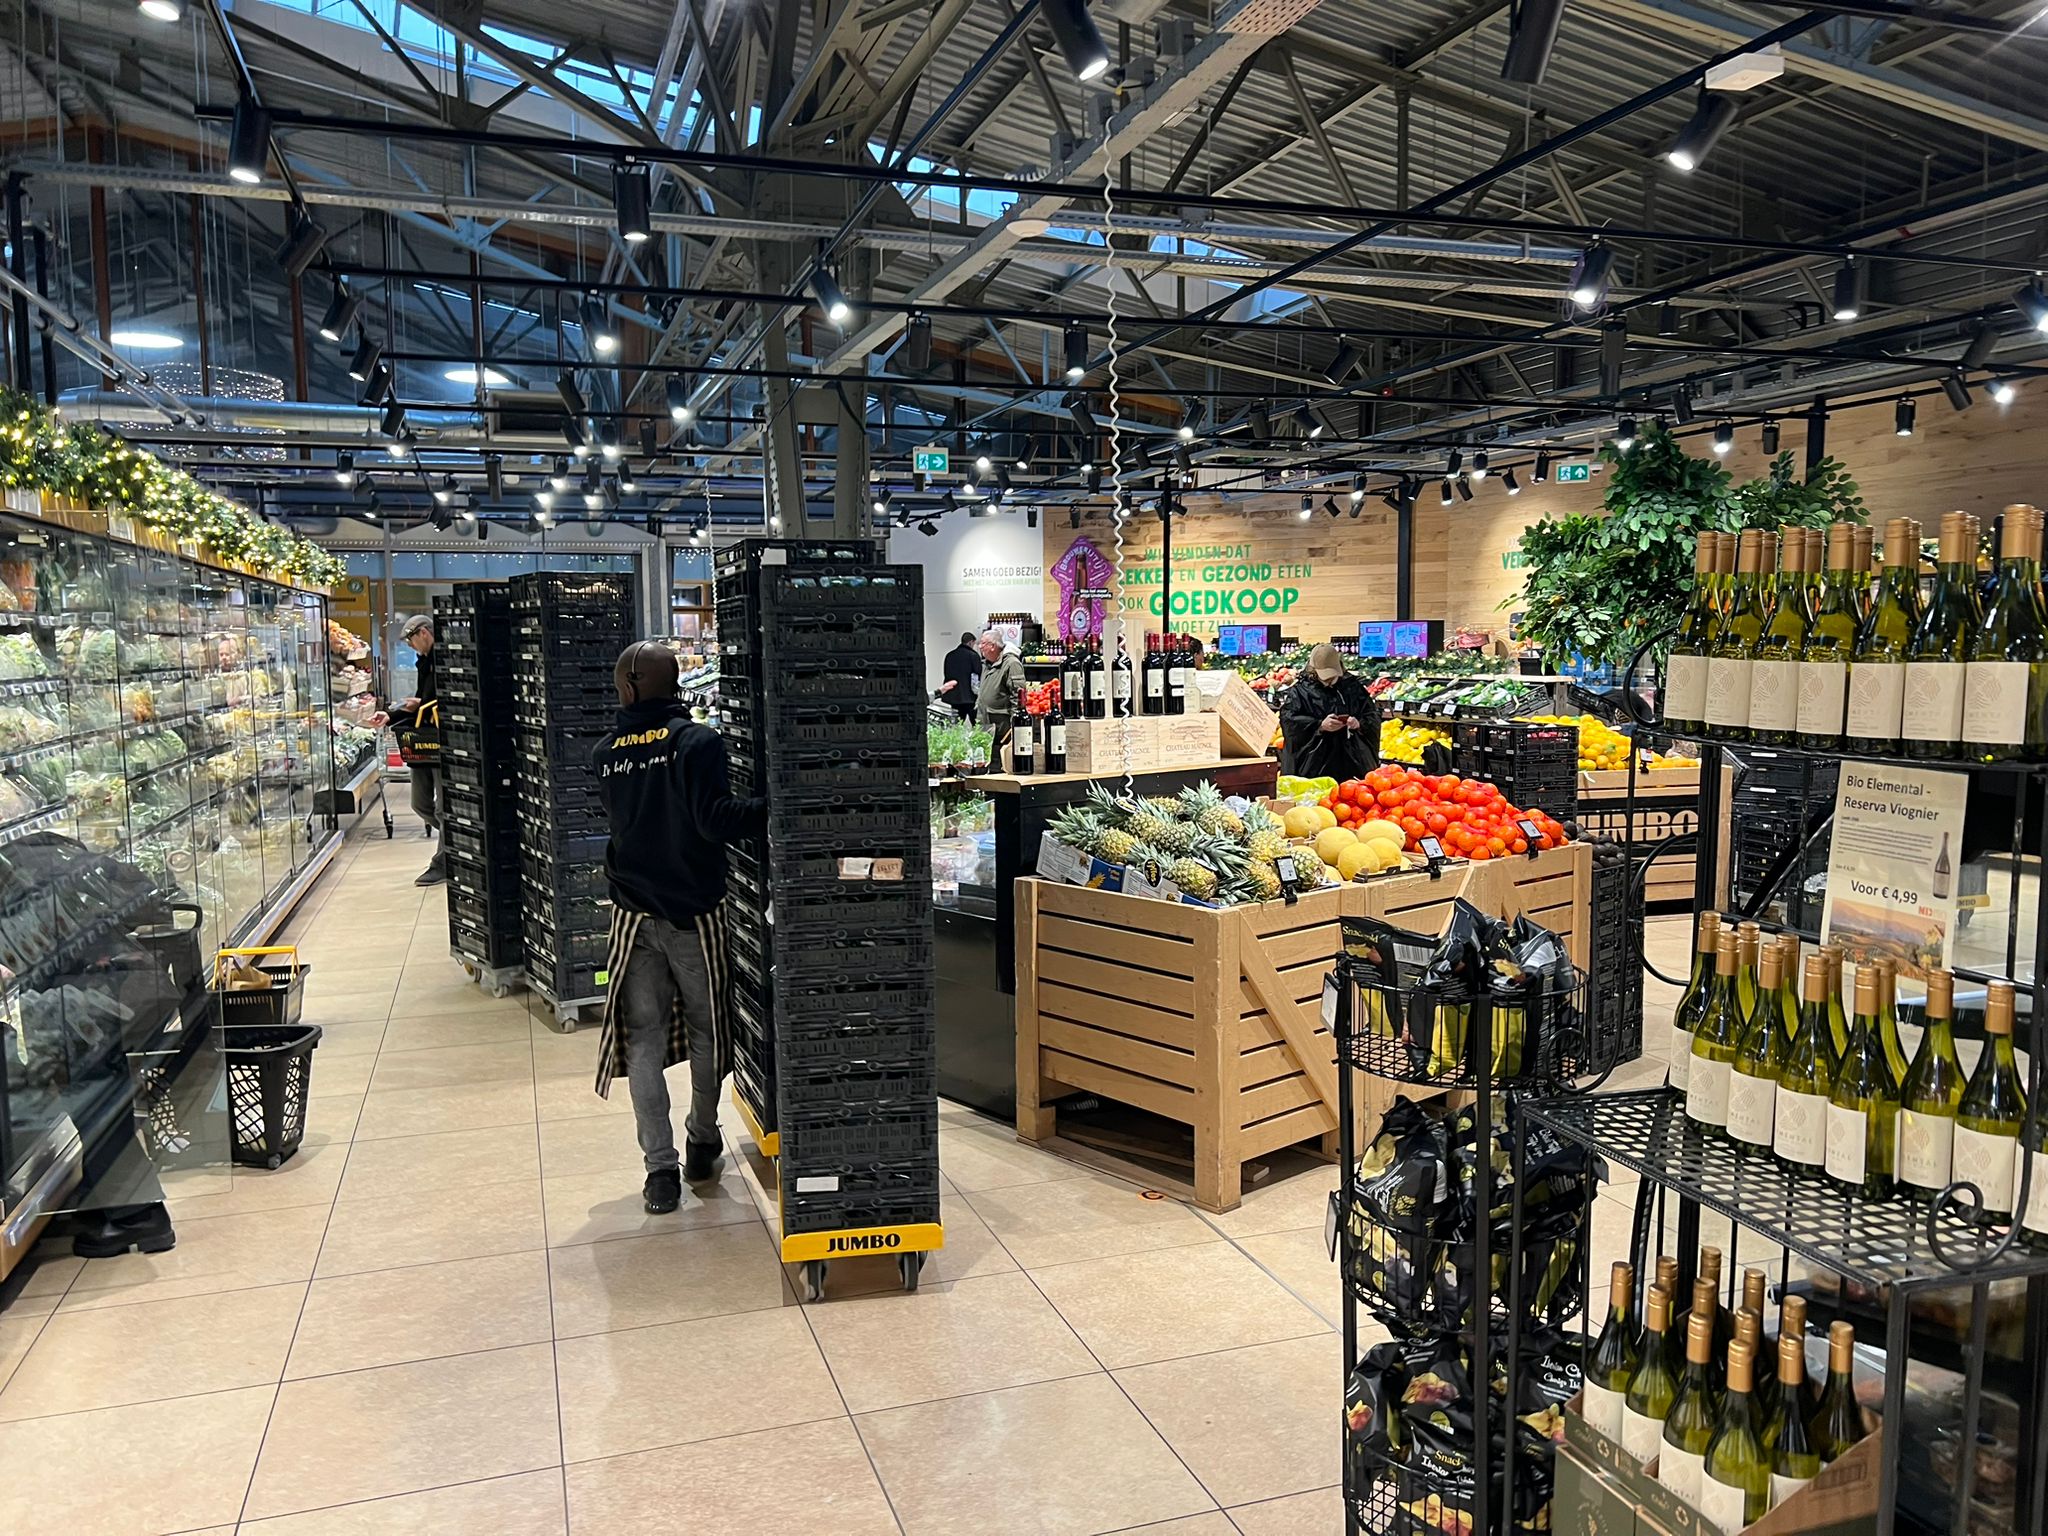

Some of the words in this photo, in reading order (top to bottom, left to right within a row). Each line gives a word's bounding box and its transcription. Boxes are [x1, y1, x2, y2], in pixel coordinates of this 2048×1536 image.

[1172, 546, 1221, 560] VINDEN
[1226, 545, 1251, 559] DAT
[963, 567, 991, 577] SAMEN
[993, 567, 1014, 577] GOED
[1180, 568, 1195, 581] EN
[1202, 564, 1272, 582] GEZOND
[1278, 564, 1312, 578] ETEN
[1149, 588, 1300, 616] GOEDKOOP
[1169, 620, 1204, 633] MOET
[414, 742, 440, 750] JUMB
[611, 727, 669, 749] JUMBO
[614, 758, 633, 774] help
[1847, 775, 1864, 788] Bio
[1867, 778, 1924, 796] Elemental
[1844, 796, 1887, 813] Reserva
[1890, 803, 1939, 821] Viognier
[1851, 879, 1878, 896] Voor
[1882, 886, 1890, 898] €
[1892, 889, 1918, 904] 4,99
[826, 1233, 901, 1253] JUMBO
